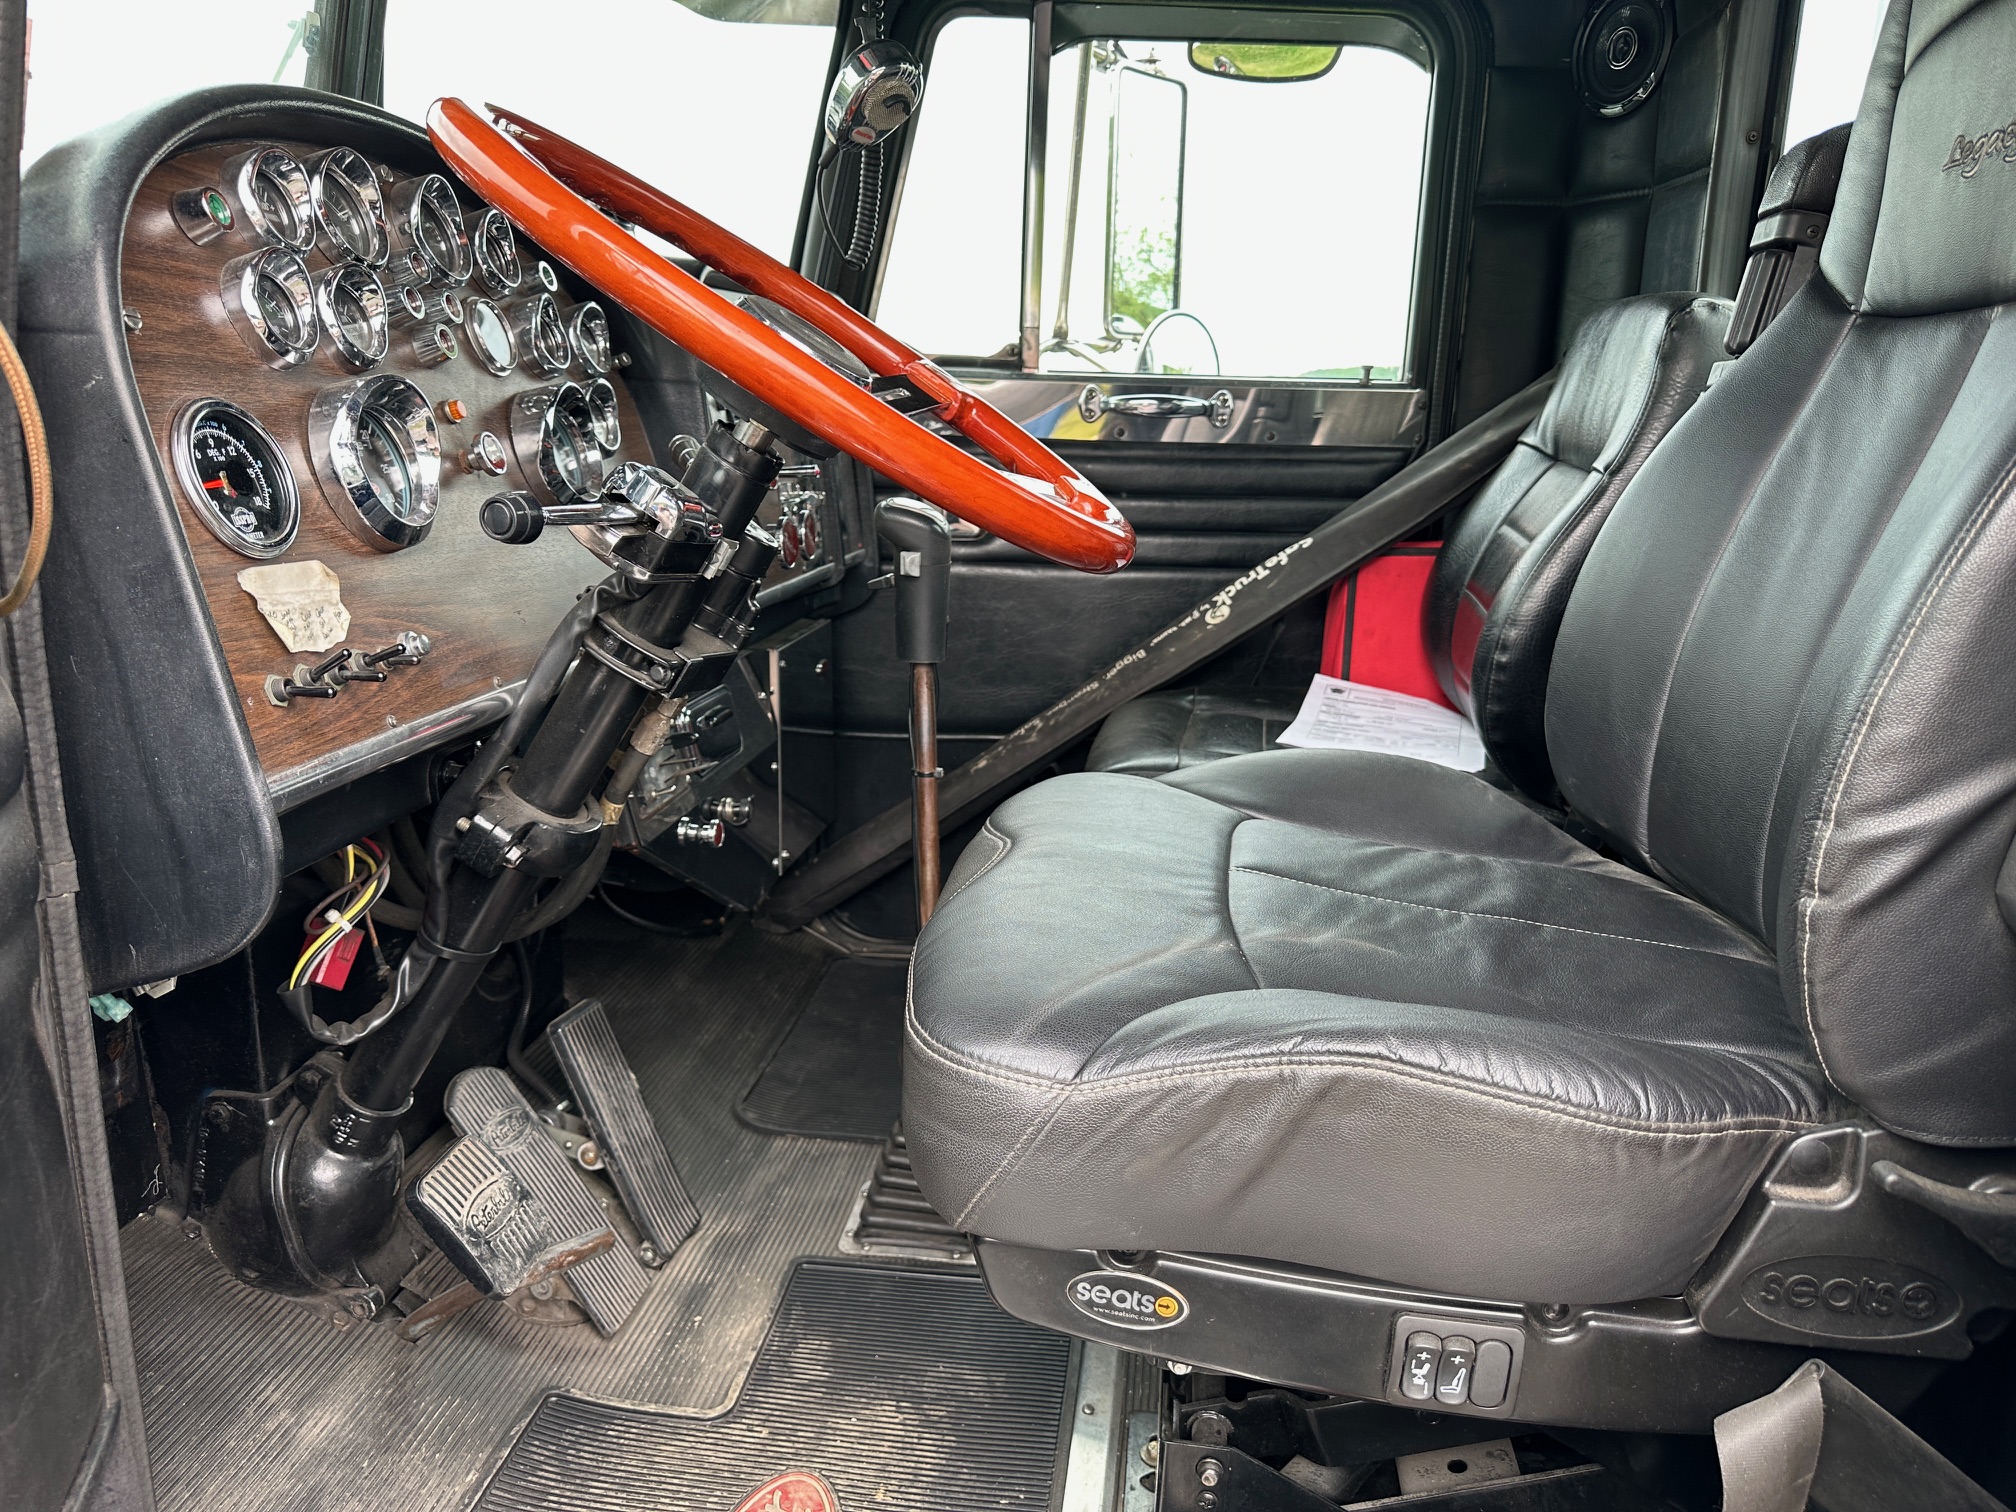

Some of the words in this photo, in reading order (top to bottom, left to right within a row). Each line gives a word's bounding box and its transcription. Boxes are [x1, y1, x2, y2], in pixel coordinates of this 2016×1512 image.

[1942, 121, 2016, 180] Legac
[208, 438, 214, 448] 9
[195, 449, 202, 459] 6
[221, 448, 226, 456] F
[226, 445, 237, 456] 12
[246, 468, 256, 478] 15
[253, 496, 263, 506] 18
[1076, 1281, 1156, 1313] seats
[1759, 1271, 1898, 1317] seats
[1092, 1305, 1156, 1322] www.seatsinc.com
